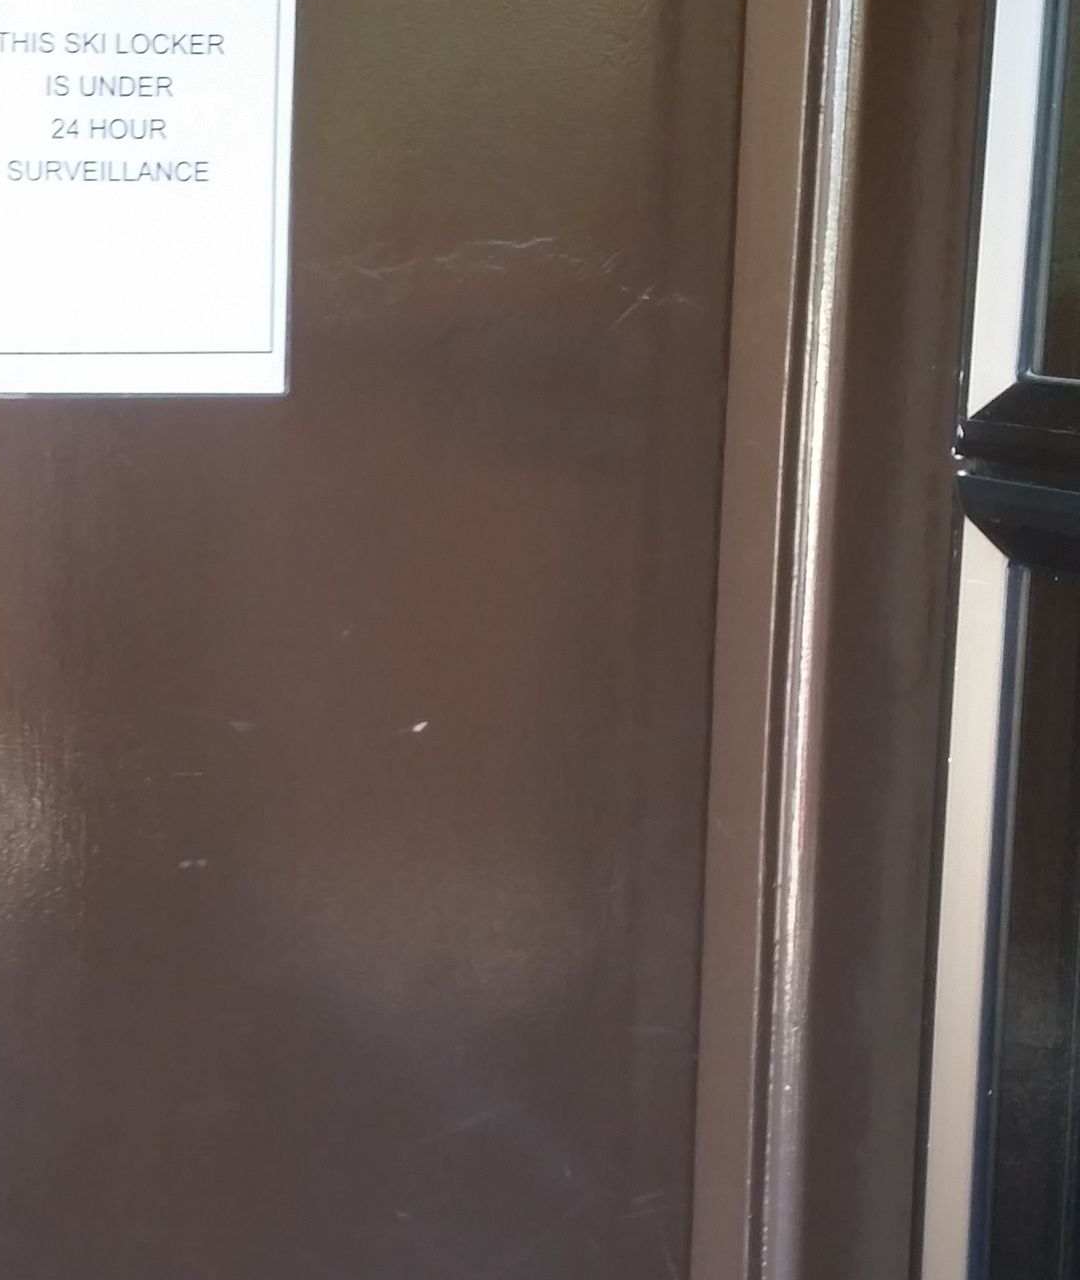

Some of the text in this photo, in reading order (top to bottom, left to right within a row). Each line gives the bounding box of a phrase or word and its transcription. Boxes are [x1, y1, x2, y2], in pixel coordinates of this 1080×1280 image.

[64, 32, 107, 54] SKI
[115, 33, 226, 55] LOCKER
[45, 75, 174, 98] IS UNDER
[51, 118, 168, 140] 24 HOUR
[7, 160, 210, 182] SURVEILLANCE
